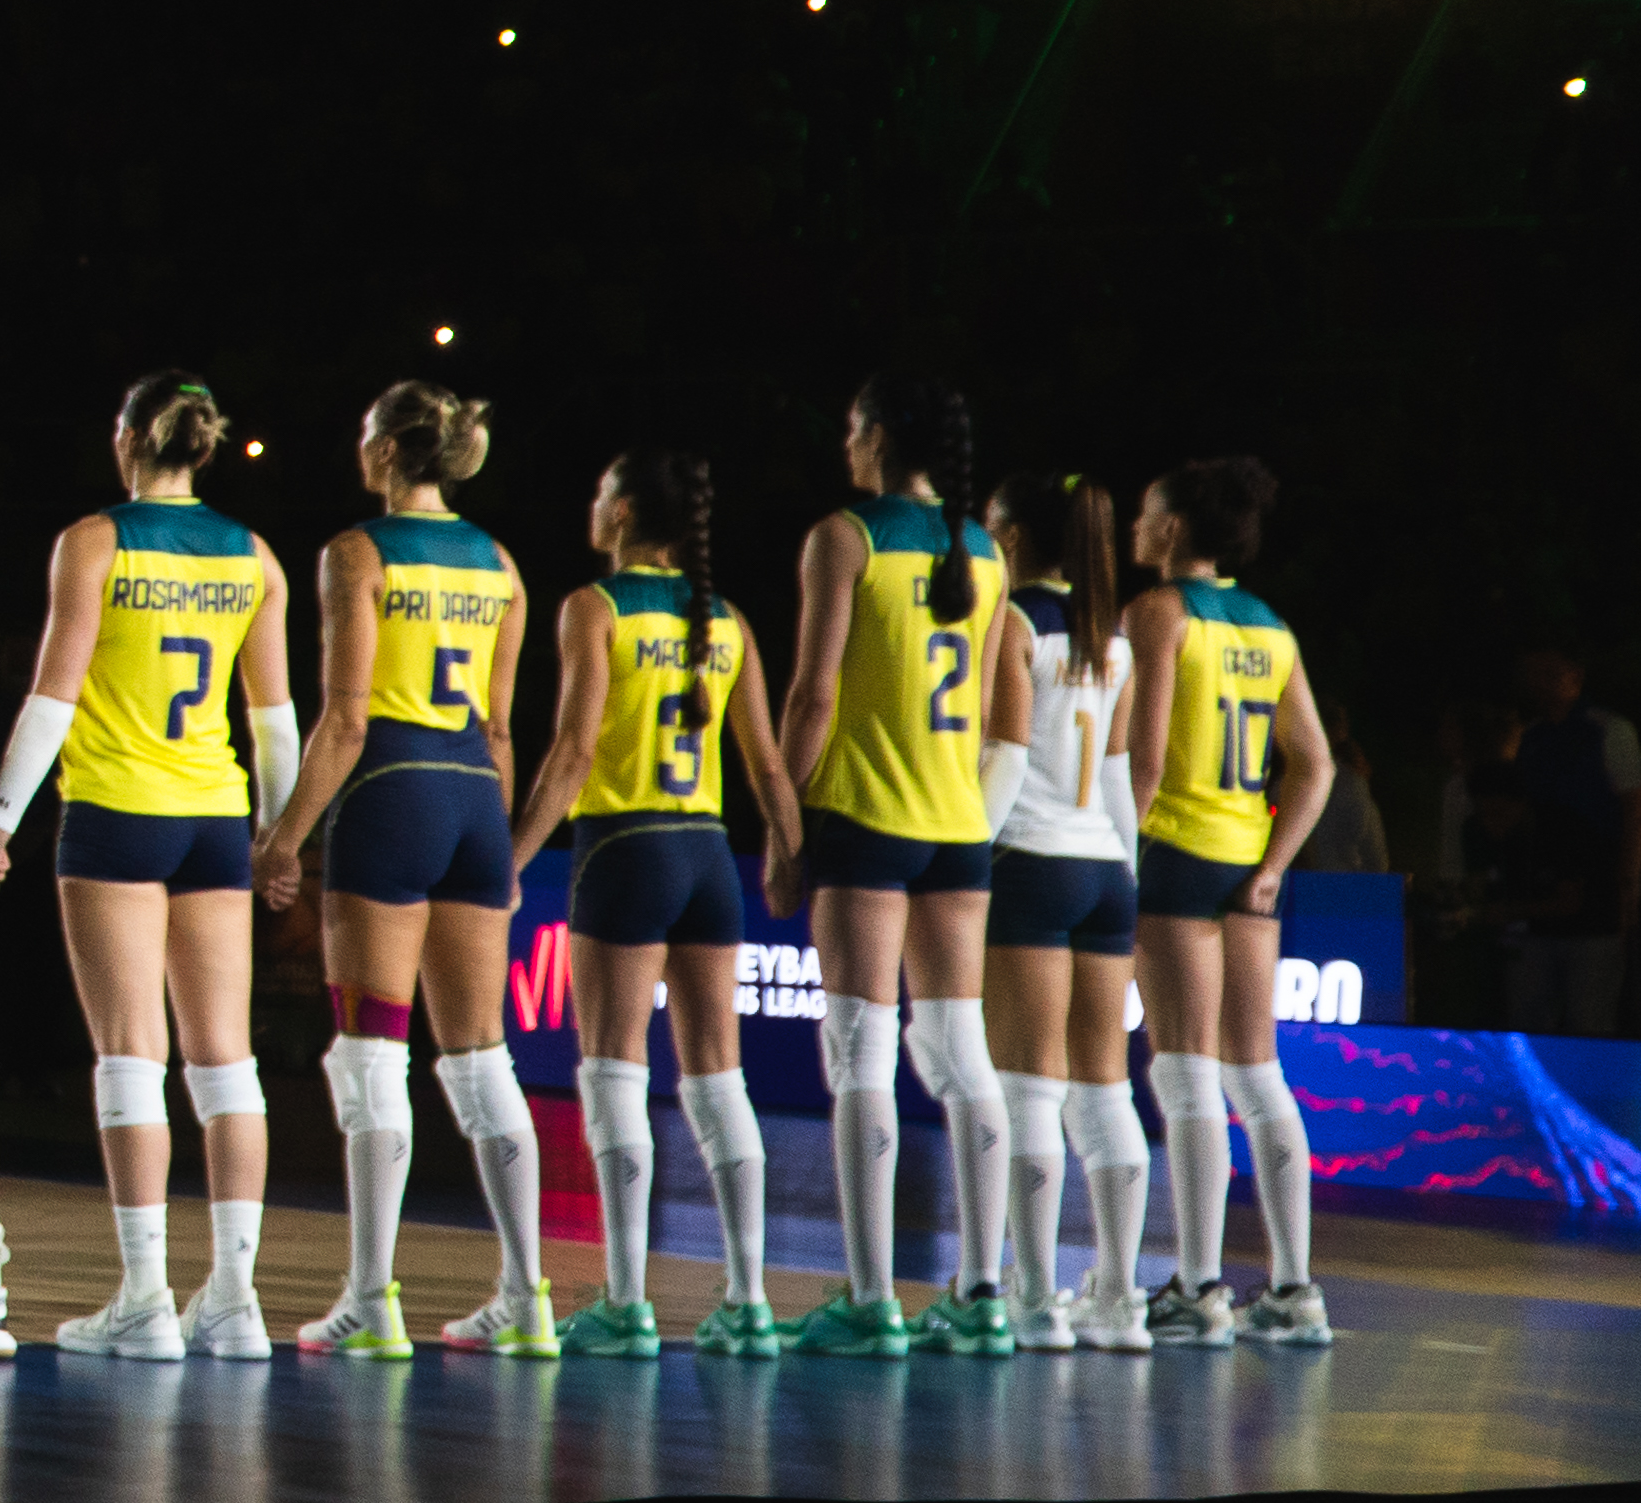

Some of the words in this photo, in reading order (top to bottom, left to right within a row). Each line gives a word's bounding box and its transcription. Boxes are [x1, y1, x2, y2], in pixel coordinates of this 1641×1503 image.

[111, 577, 256, 614] ROSAMARIA
[384, 590, 431, 620] PRI
[160, 636, 213, 740] 7
[430, 647, 477, 723] 5
[927, 631, 969, 732] 2
[658, 694, 704, 796] 3
[1075, 709, 1095, 809] 1
[1218, 696, 1277, 792] 10
